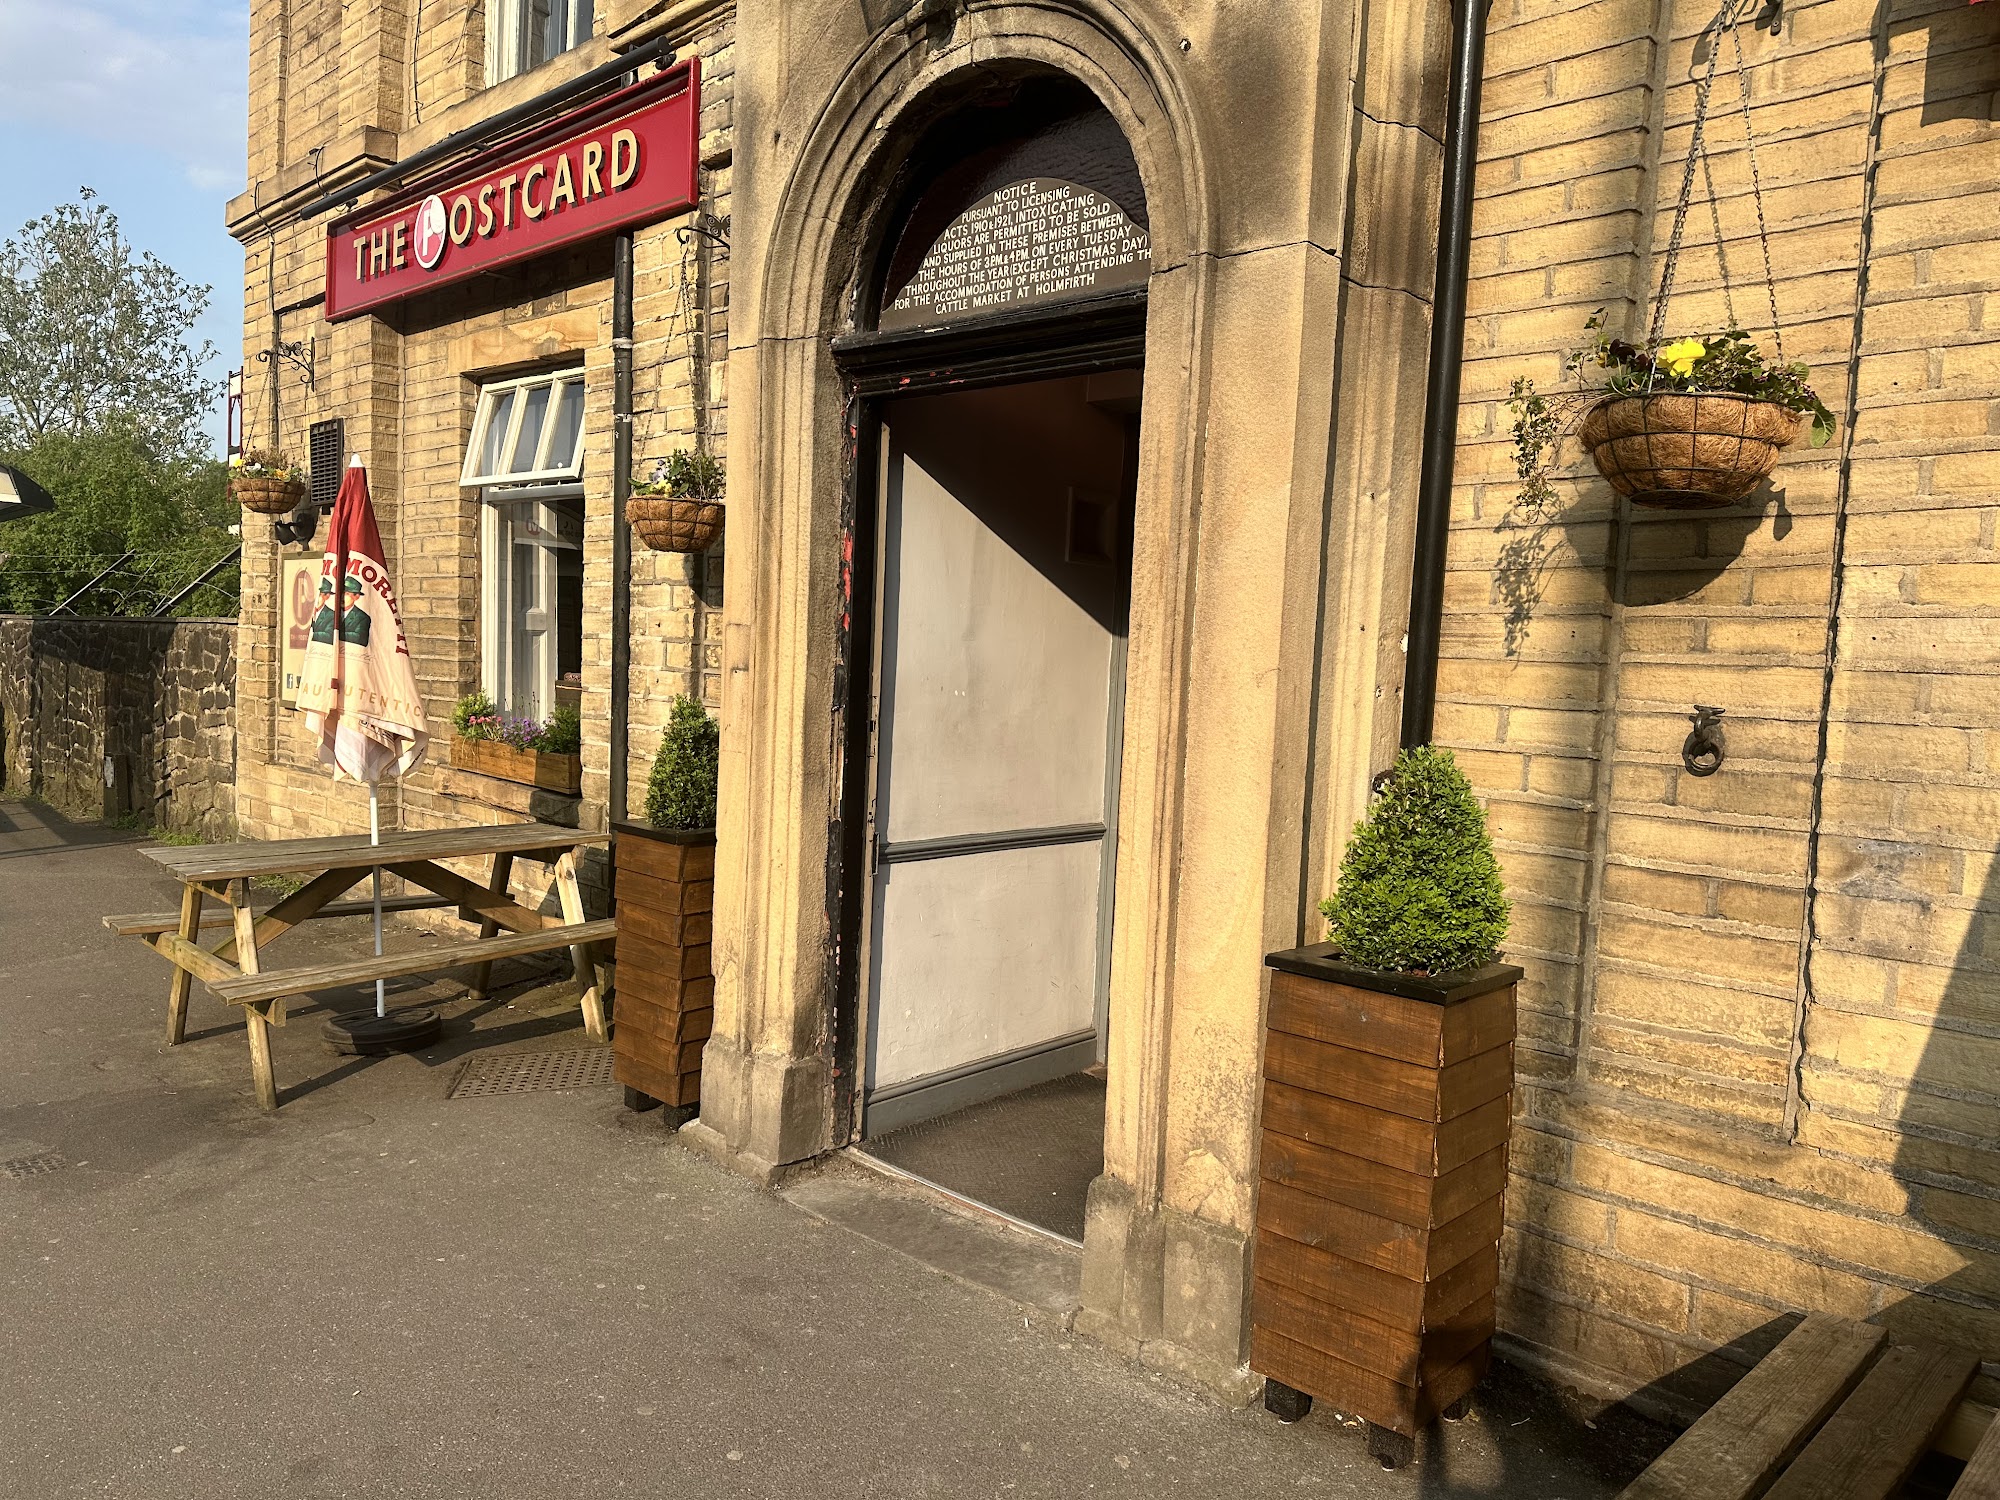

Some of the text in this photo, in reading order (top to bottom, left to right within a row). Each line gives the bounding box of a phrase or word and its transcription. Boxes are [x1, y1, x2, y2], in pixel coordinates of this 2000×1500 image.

[353, 128, 639, 280] THE POSTCARD
[944, 225, 968, 240] ACTS
[1016, 194, 1094, 223] INTOXICATING
[962, 186, 1070, 223] PURSUANT TO LICENSING
[994, 182, 1036, 203] NOTICE
[919, 268, 935, 281] THE
[939, 262, 968, 277] HOURS
[971, 259, 982, 270] OF
[1032, 247, 1046, 257] ON
[1049, 237, 1079, 254] EVERY
[1083, 225, 1132, 246] TUESDAY
[923, 213, 1123, 268] AND SUPPLIED IN THESE PREMISES BETWEEN
[934, 203, 1110, 254] LIQUORS ARE PERMITTED TO BE SOLD
[895, 248, 1151, 310] FOR THE ACCOMMODATION OF PERSONS ATTENDING TH
[905, 275, 966, 296] THROUGHOUT
[969, 271, 985, 283] THE
[1053, 242, 1116, 266] CHRISTMAS
[1122, 234, 1147, 252] DAY)
[936, 273, 1095, 315] CATTLE MARKET AT HOLMFIRTH
